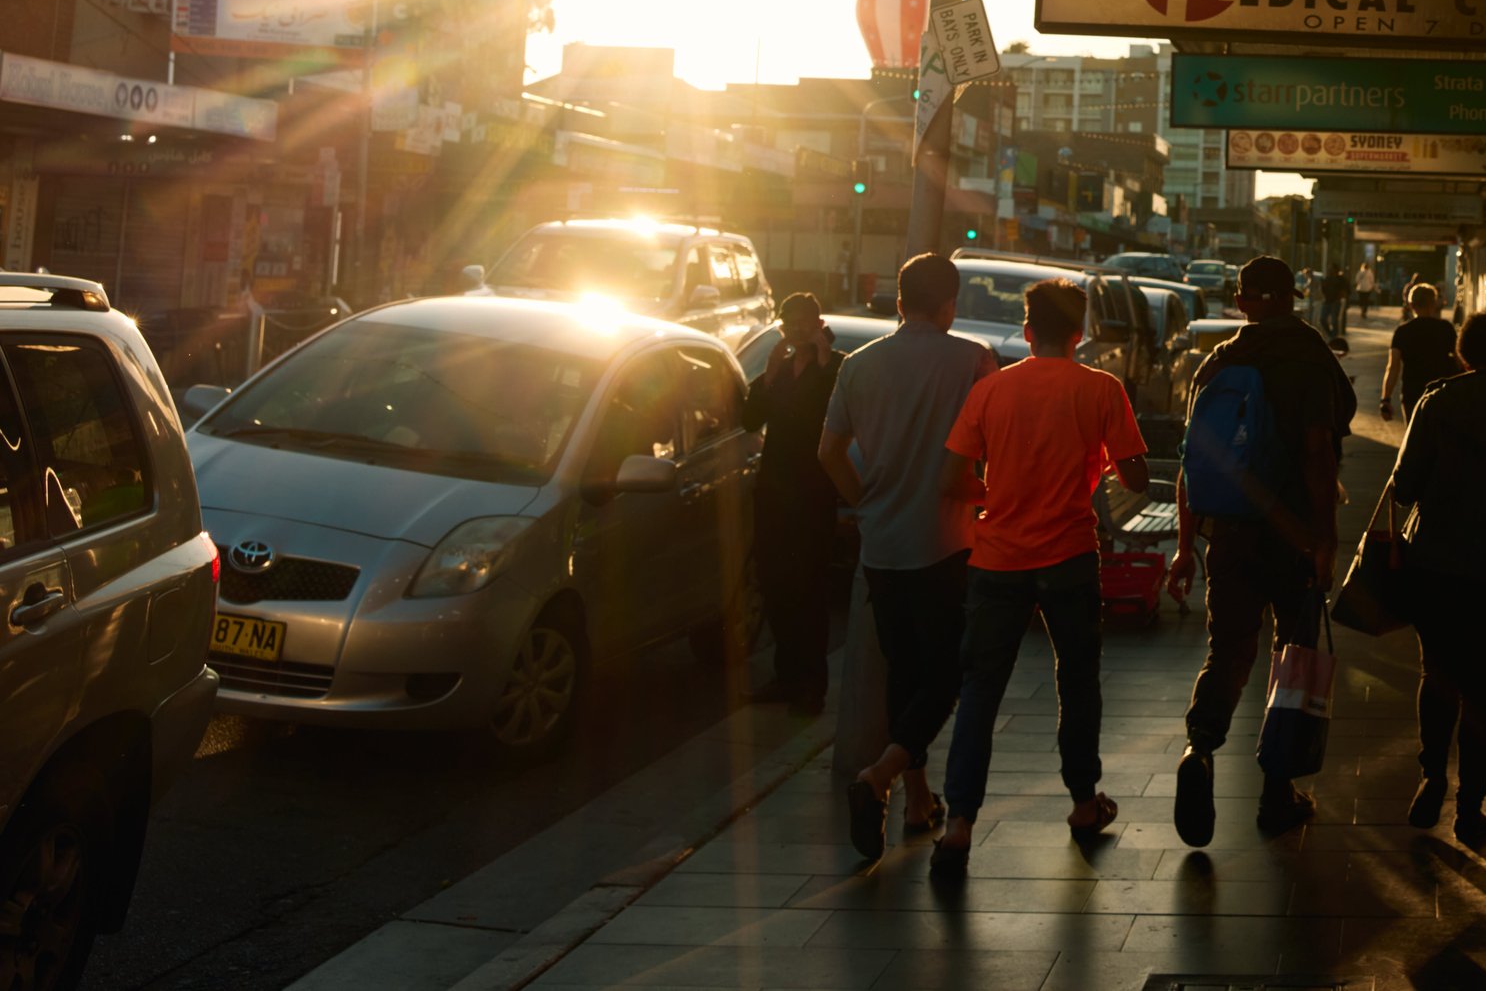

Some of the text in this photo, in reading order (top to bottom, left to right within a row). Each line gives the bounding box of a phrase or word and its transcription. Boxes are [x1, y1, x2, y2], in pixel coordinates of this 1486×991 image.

[963, 12, 988, 64] PARK IN
[1304, 13, 1394, 33] OPEN
[1425, 19, 1440, 35] 7
[940, 9, 970, 78] BAYS ONLY
[1233, 78, 1406, 112] starrpartners
[1434, 73, 1484, 91] Strata
[1351, 135, 1402, 150] SYDNEY
